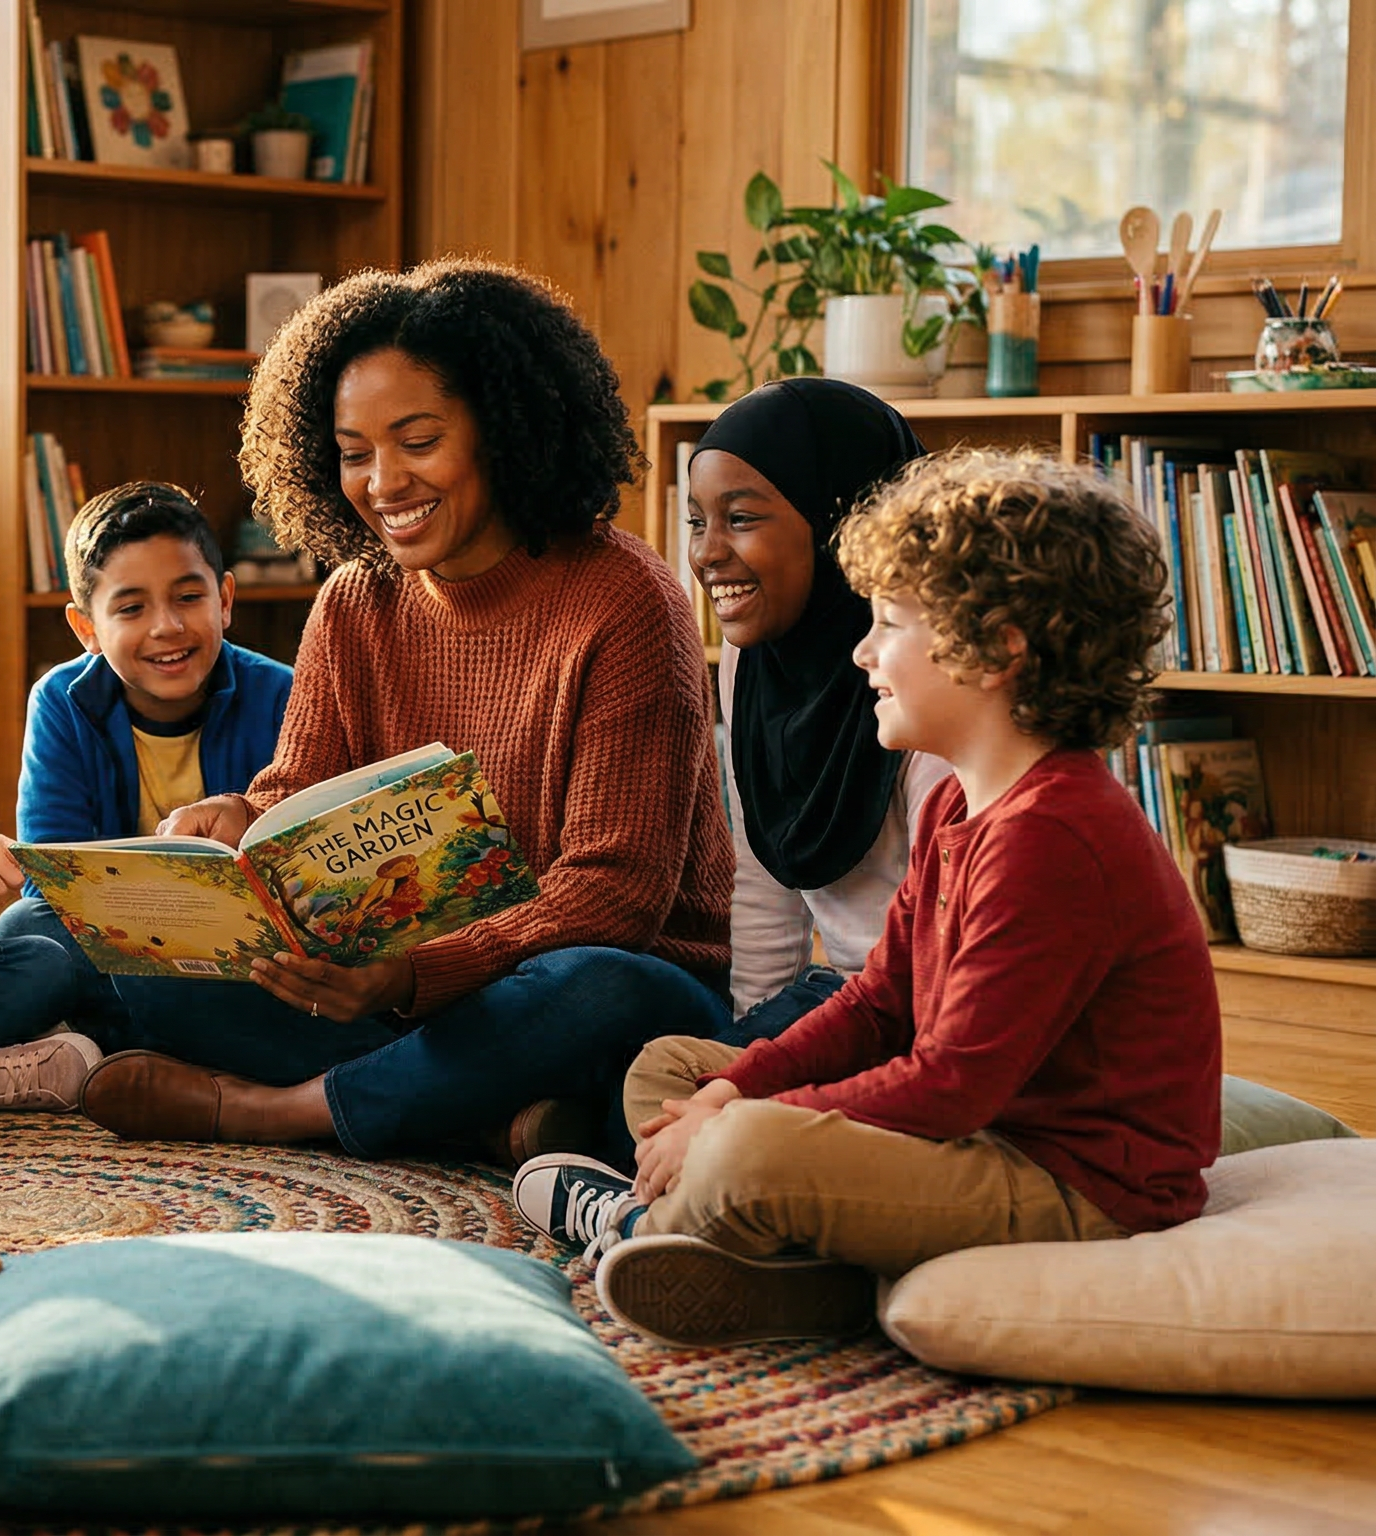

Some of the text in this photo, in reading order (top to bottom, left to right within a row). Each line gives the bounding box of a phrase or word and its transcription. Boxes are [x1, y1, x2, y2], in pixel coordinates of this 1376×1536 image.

[302, 793, 443, 861] THE MAGIC
[326, 818, 433, 874] GARDEN
